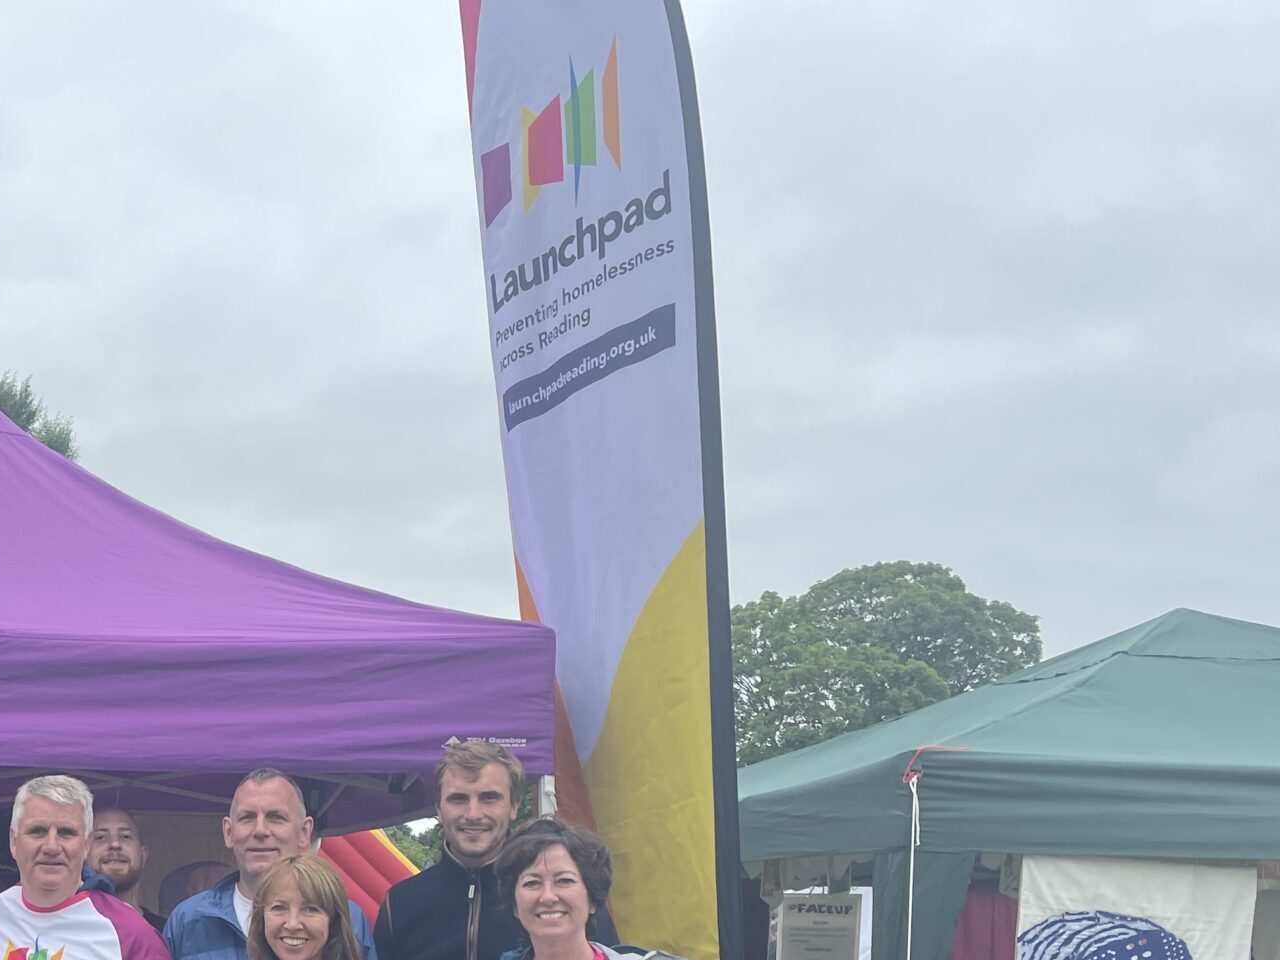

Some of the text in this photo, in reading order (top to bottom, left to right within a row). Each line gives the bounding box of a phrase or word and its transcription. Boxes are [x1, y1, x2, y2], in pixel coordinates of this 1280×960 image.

[489, 168, 672, 314] Launchpad
[496, 240, 675, 349] Preventing homelessness
[538, 308, 591, 351] Reading
[508, 326, 657, 415] launchpadreading.org.uk
